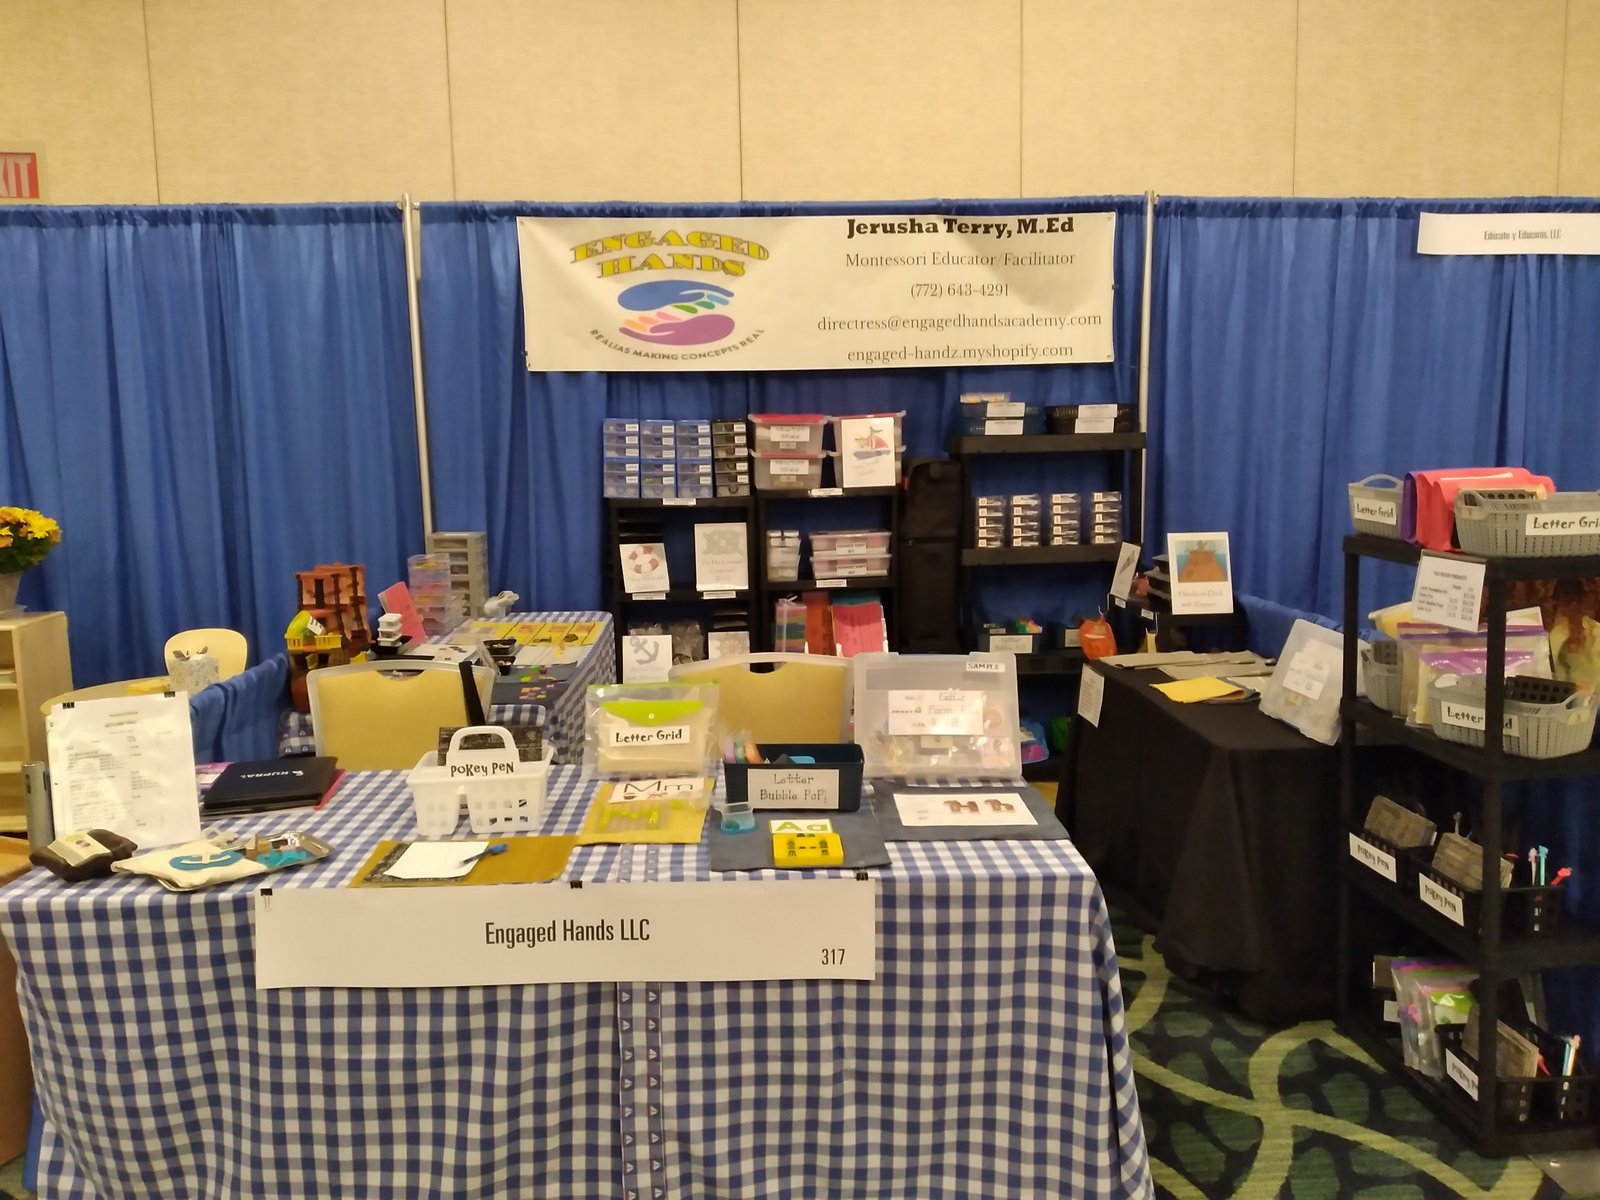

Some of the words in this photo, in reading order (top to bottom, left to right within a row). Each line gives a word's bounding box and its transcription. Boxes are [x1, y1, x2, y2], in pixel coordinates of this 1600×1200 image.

[847, 218, 939, 239] Jerusha
[943, 217, 1013, 239] Terry,
[1016, 216, 1075, 234] M.Ed
[569, 229, 770, 264] ENGAGED
[597, 253, 746, 278] HANDS
[846, 252, 926, 267] Montessori
[932, 251, 996, 267] Educator
[1003, 251, 1076, 267] Facilitator
[910, 283, 943, 298] (772)
[947, 283, 1010, 297] 643-4291
[817, 314, 1102, 331] directress@engagedhandsacademy.com
[590, 329, 631, 354] REALIAS
[633, 349, 679, 360] MAKING
[681, 345, 740, 360] CONCEPTS
[740, 328, 765, 348] REAL
[847, 344, 1074, 363] engaged-handz.myshopify.com
[1357, 503, 1377, 514] Letter
[1533, 516, 1575, 530] Letter
[1579, 516, 1600, 529] Gri
[1447, 706, 1484, 723] Letter
[615, 732, 654, 743] Letter
[656, 728, 682, 740] Grid
[774, 773, 814, 784] Letter
[760, 789, 798, 801] Bubble
[485, 920, 557, 949] Engaged
[563, 919, 614, 941] Hands
[620, 918, 650, 941] LLC
[821, 948, 846, 966] 317
